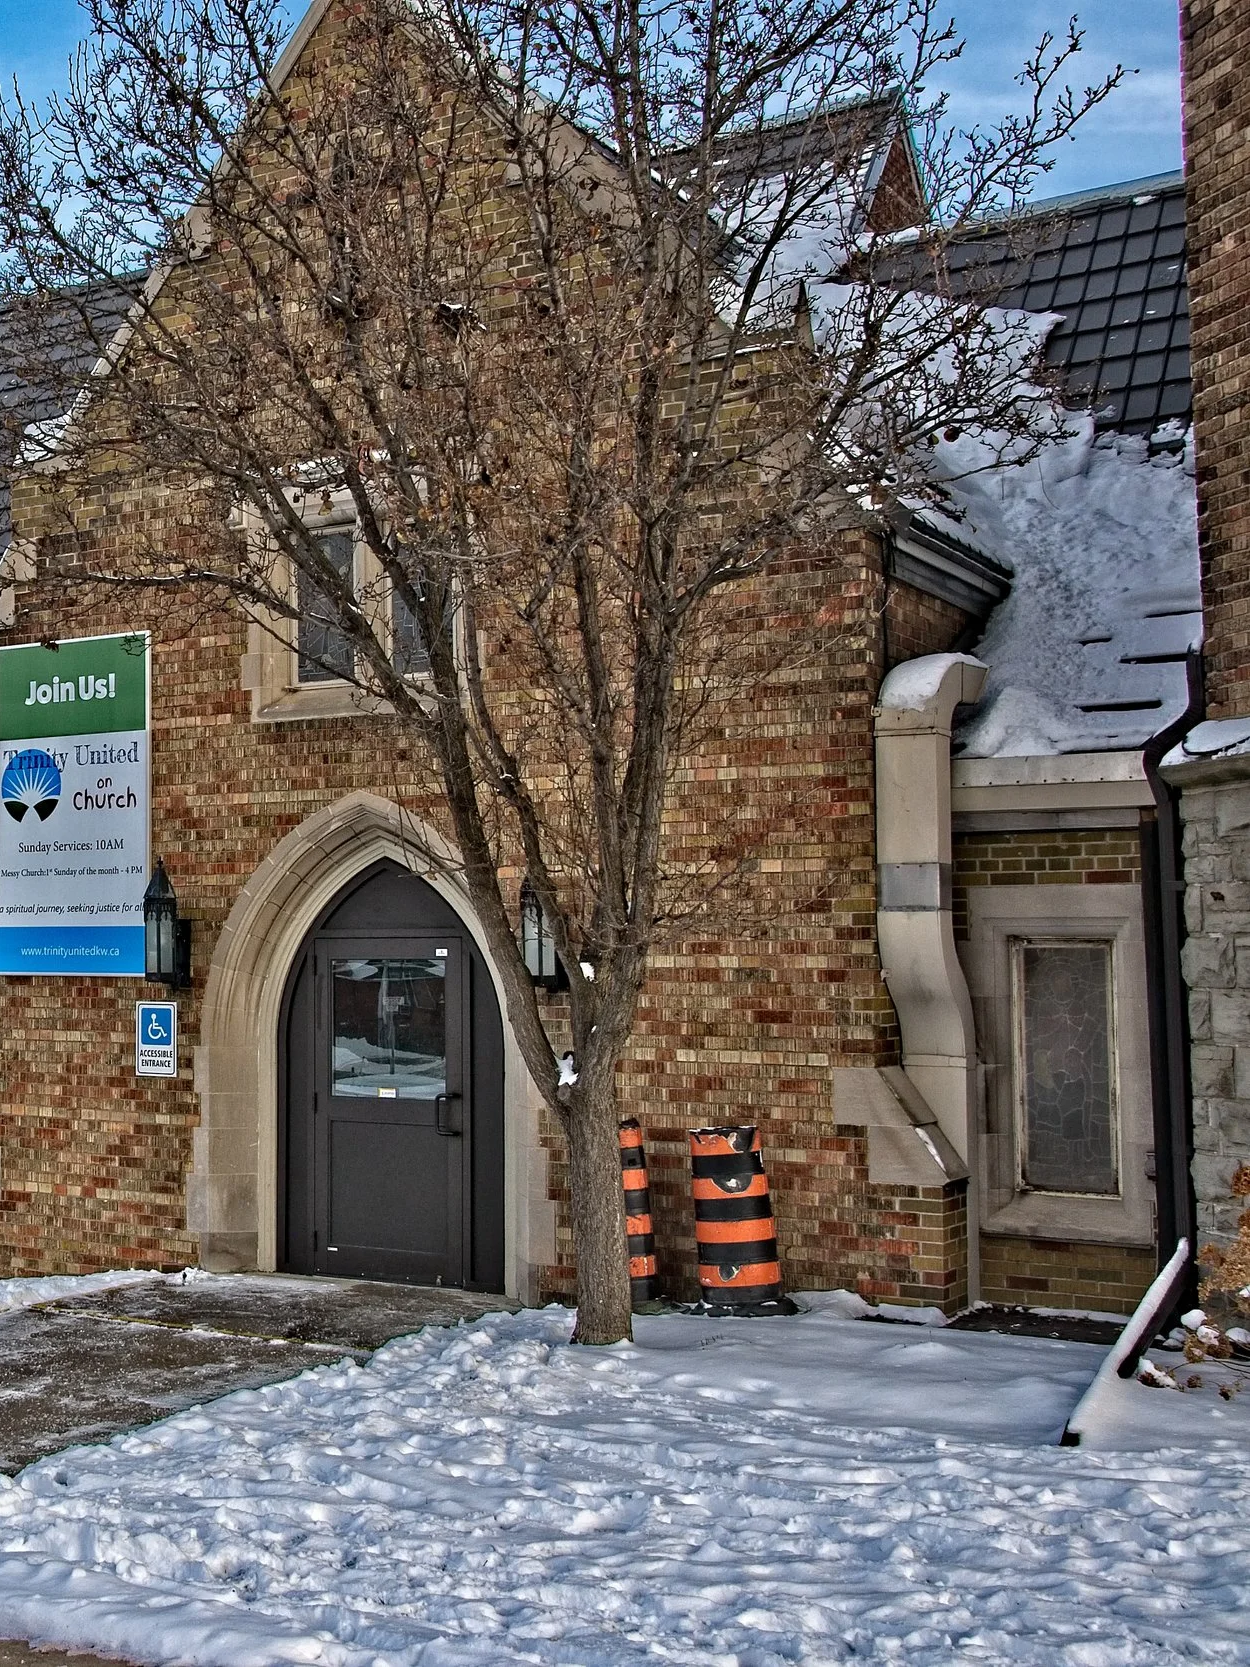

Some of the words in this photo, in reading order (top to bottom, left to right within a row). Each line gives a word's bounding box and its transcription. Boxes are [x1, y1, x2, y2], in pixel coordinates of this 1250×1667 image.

[25, 676, 75, 706] Join
[78, 673, 116, 700] Us!
[3, 748, 69, 772] Trinity
[74, 741, 139, 766] United
[97, 777, 112, 789] on
[73, 786, 137, 811] Church
[18, 841, 51, 855] Sunday
[53, 840, 93, 852] Services:
[96, 838, 124, 850] 10AM
[1, 869, 20, 879] Messy
[53, 867, 77, 877] Sunday
[78, 866, 86, 875] of
[86, 866, 97, 875] the
[98, 866, 119, 875] month
[125, 866, 130, 874] 4
[131, 865, 143, 874] PM
[5, 903, 35, 915] spiritual
[34, 903, 65, 915] journey,
[66, 903, 95, 915] seeking
[95, 902, 120, 915] justice
[121, 902, 133, 913] for
[20, 945, 120, 959] www.trinityunitedkw.ca
[140, 1049, 173, 1058] ACCESSIBLE
[141, 1059, 171, 1068] ENTRANCE
